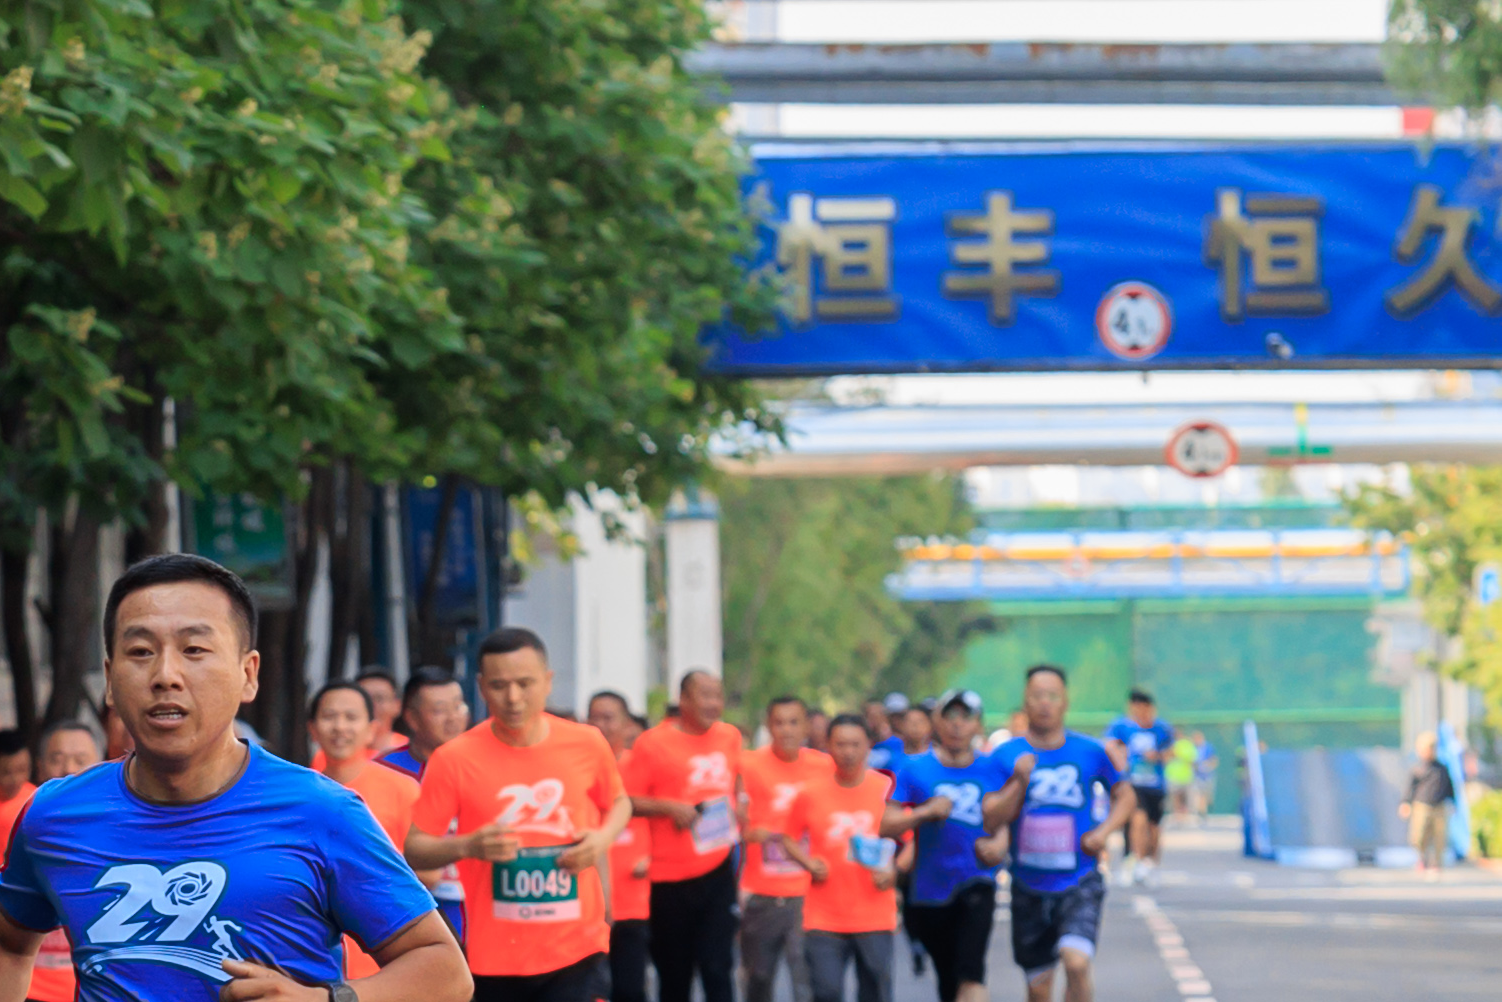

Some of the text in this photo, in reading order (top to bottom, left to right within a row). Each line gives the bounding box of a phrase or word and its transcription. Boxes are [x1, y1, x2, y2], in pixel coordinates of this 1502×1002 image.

[497, 778, 564, 823] 29
[86, 861, 227, 944] 29
[501, 868, 572, 898] L0049
